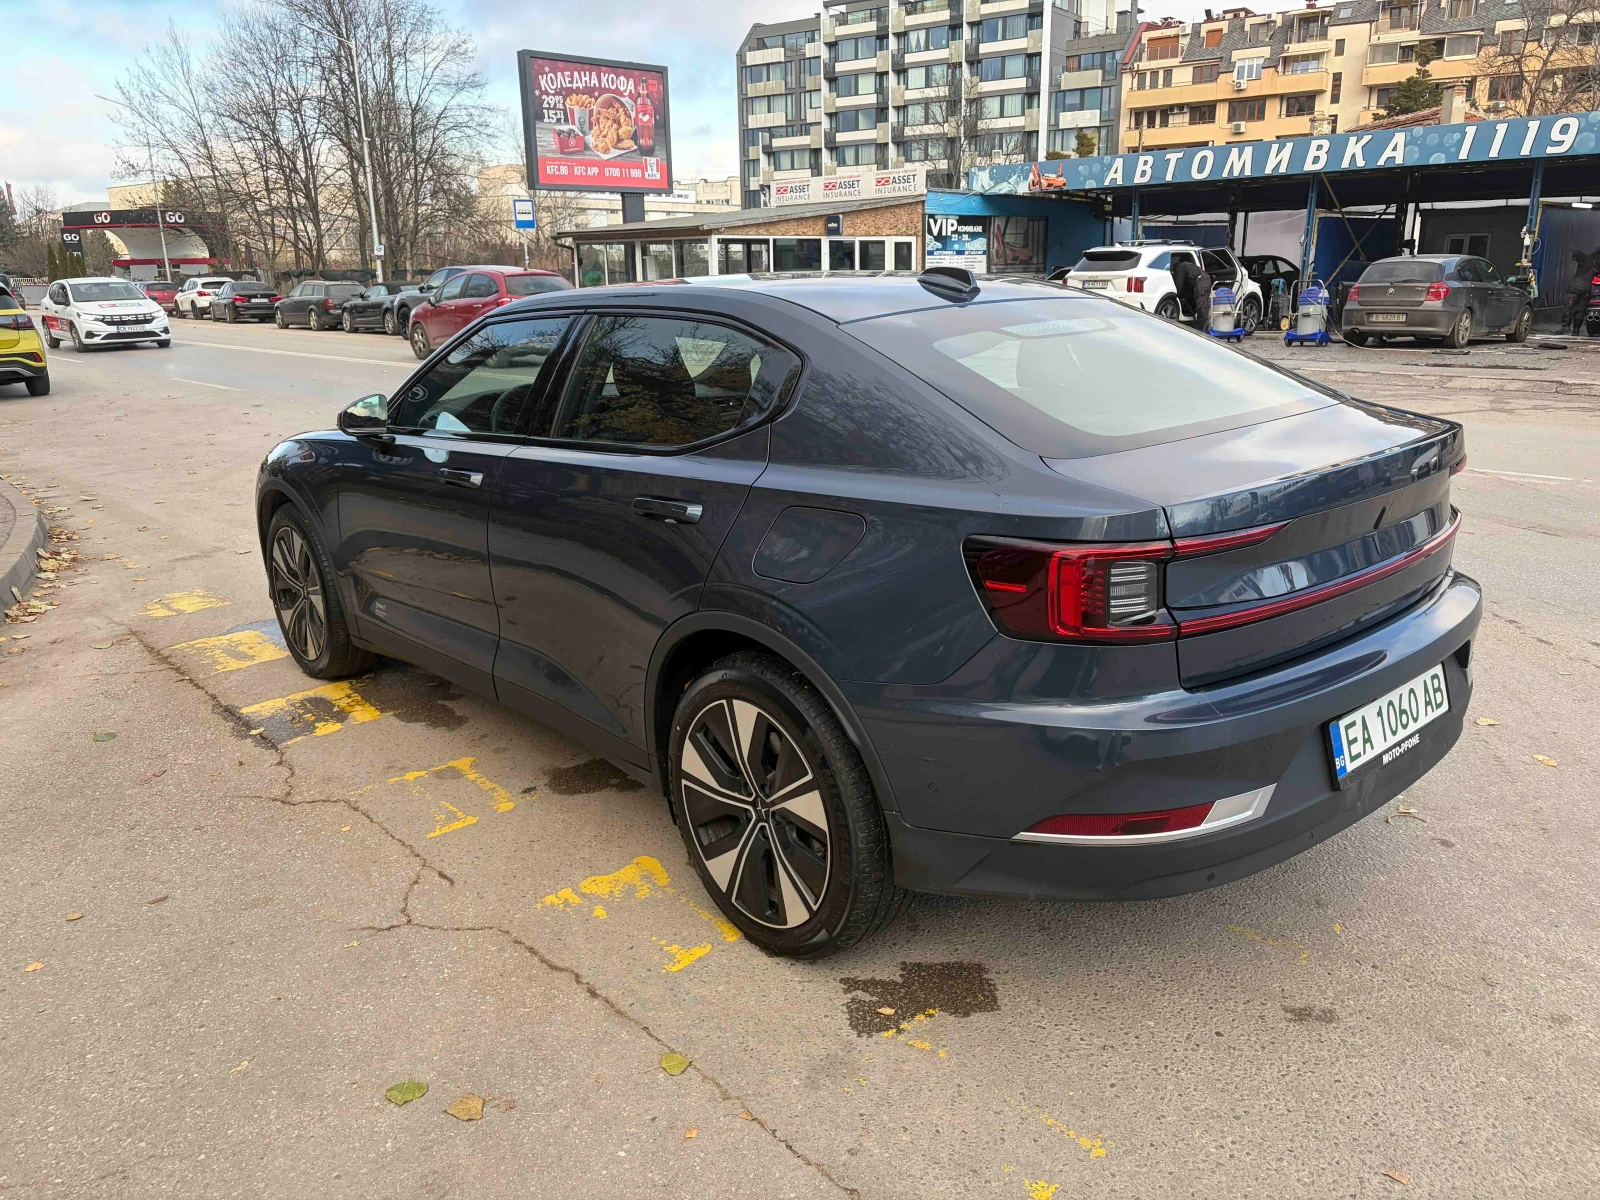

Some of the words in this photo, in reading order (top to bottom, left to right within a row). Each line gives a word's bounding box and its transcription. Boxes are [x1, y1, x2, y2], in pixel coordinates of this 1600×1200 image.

[539, 71, 599, 93] КОЛЕДНА
[601, 72, 635, 96] КОФА
[1104, 131, 1407, 187] АВТОМИВКА
[1457, 116, 1580, 161] 1119
[546, 165, 569, 175] KFC.BG
[574, 166, 586, 175] KFC
[587, 167, 599, 176] APP
[604, 167, 620, 177] 0700
[622, 168, 629, 177] 11
[630, 169, 642, 178] 999
[838, 180, 861, 190] ASSET
[892, 174, 917, 185] ASSET
[790, 184, 810, 194] ASSET
[823, 190, 861, 198] INSURANCE
[875, 184, 917, 194] INSURANCE
[775, 194, 810, 203] INSURANCE
[93, 212, 111, 223] GO
[165, 212, 185, 223] GO
[929, 218, 958, 236] VIP
[63, 233, 80, 241] GO
[1335, 755, 1345, 769] BG
[1344, 714, 1375, 763] EA
[1376, 687, 1419, 743] 1060
[1422, 672, 1444, 717] AB
[1382, 734, 1420, 765] MOTO-PFOHE
